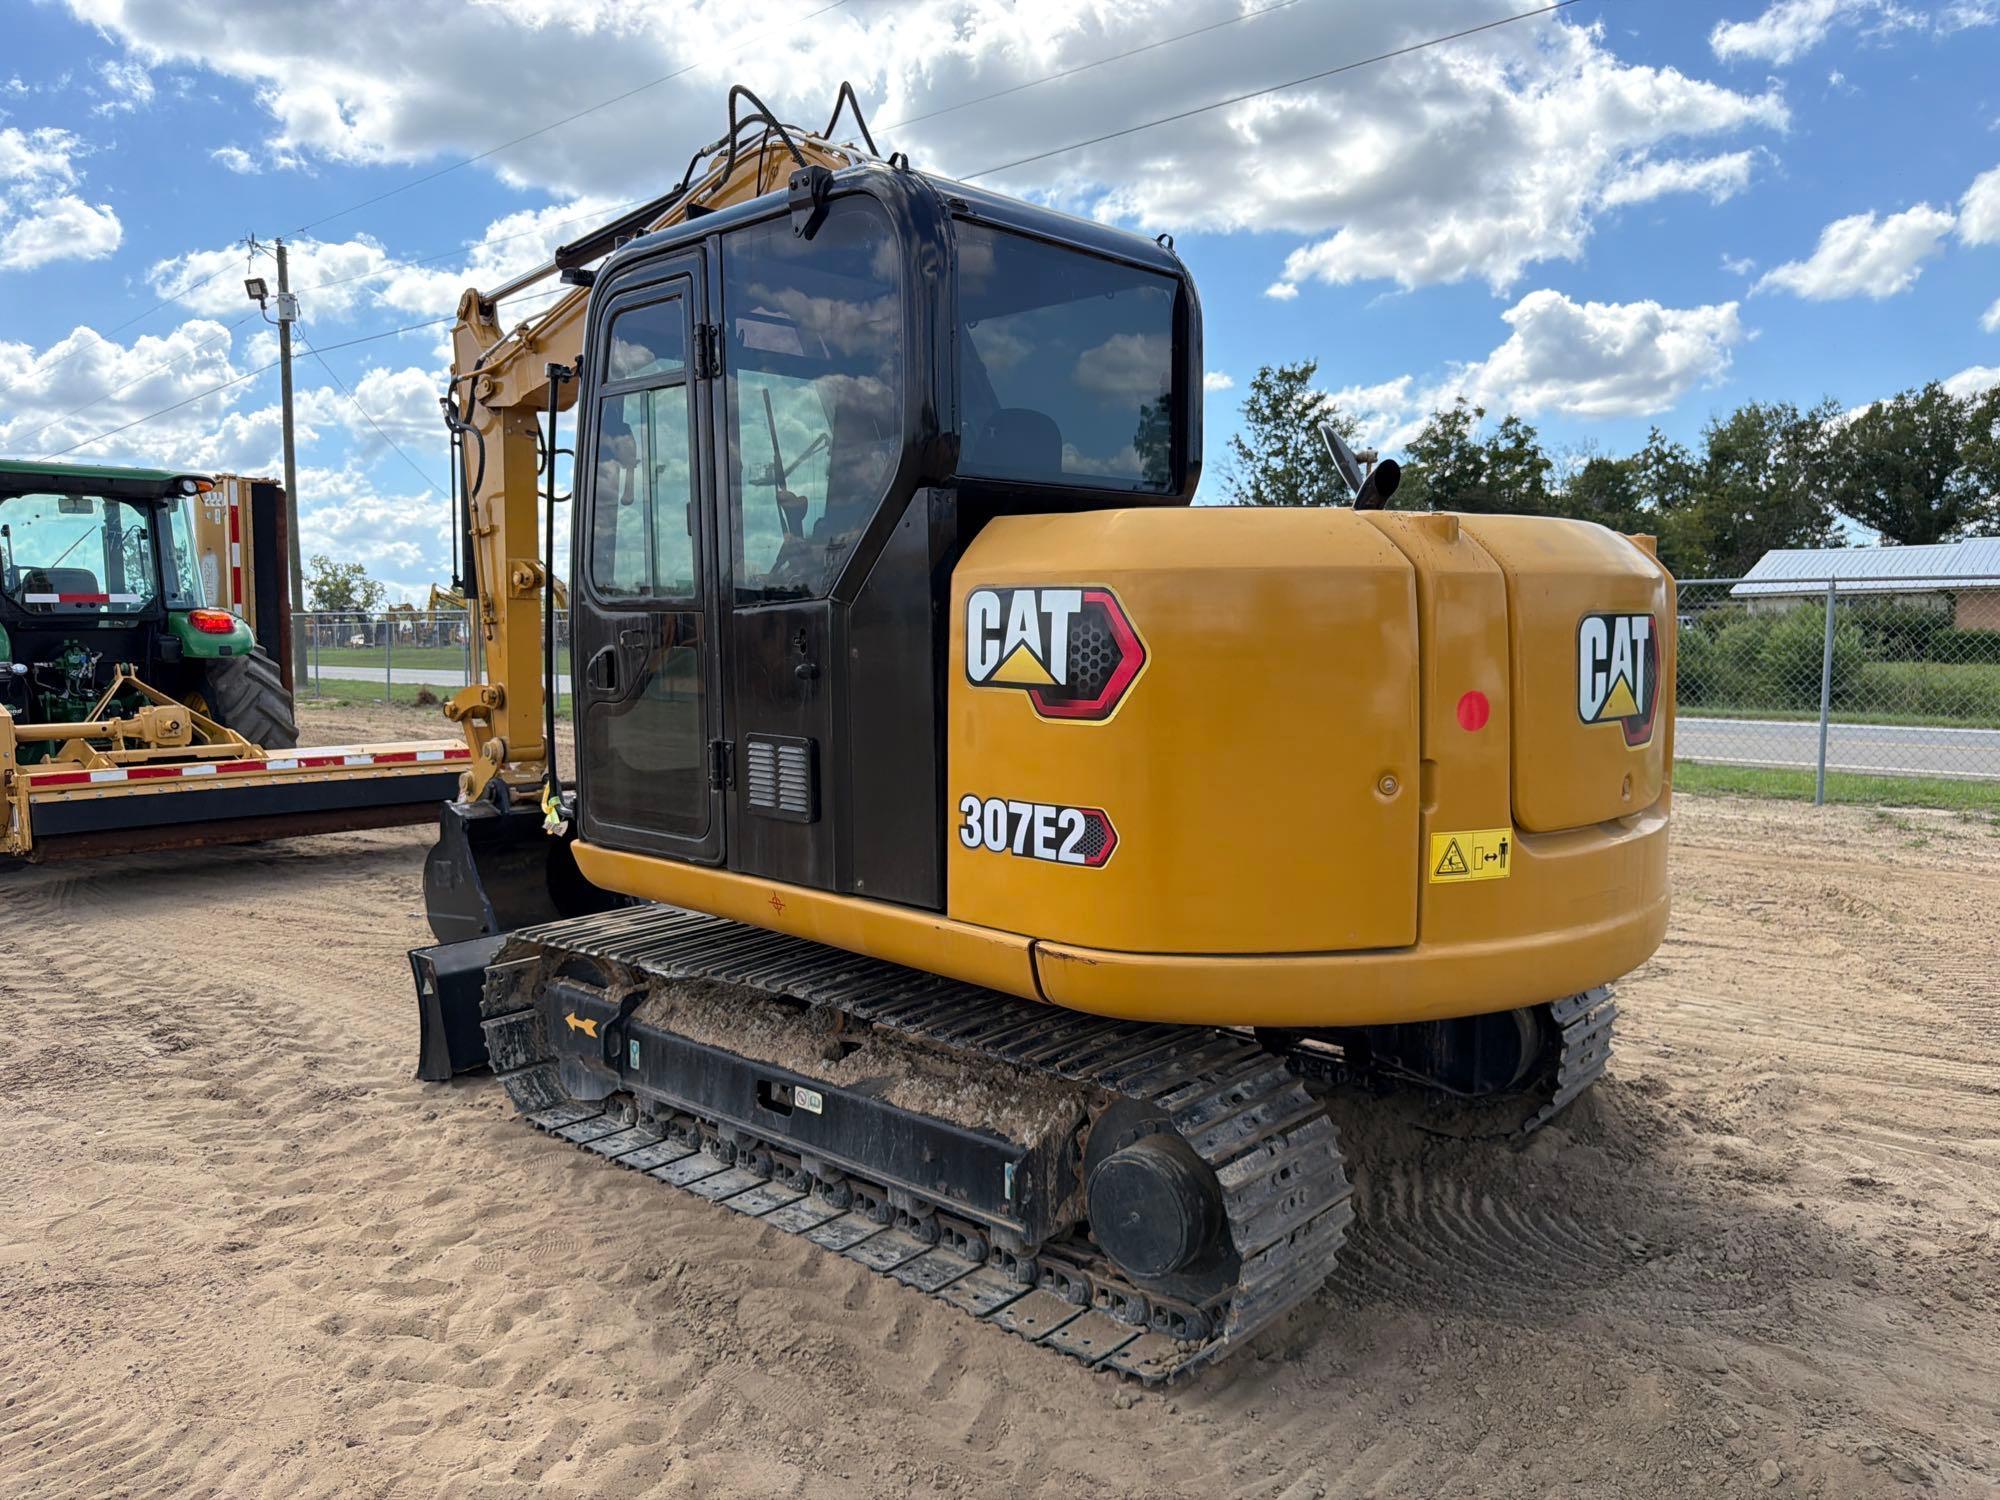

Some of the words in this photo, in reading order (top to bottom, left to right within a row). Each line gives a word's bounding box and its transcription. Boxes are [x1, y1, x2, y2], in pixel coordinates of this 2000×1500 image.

[968, 590, 1081, 685] CAT
[1580, 617, 1649, 721] CAT
[960, 795, 1086, 864] 307E2
